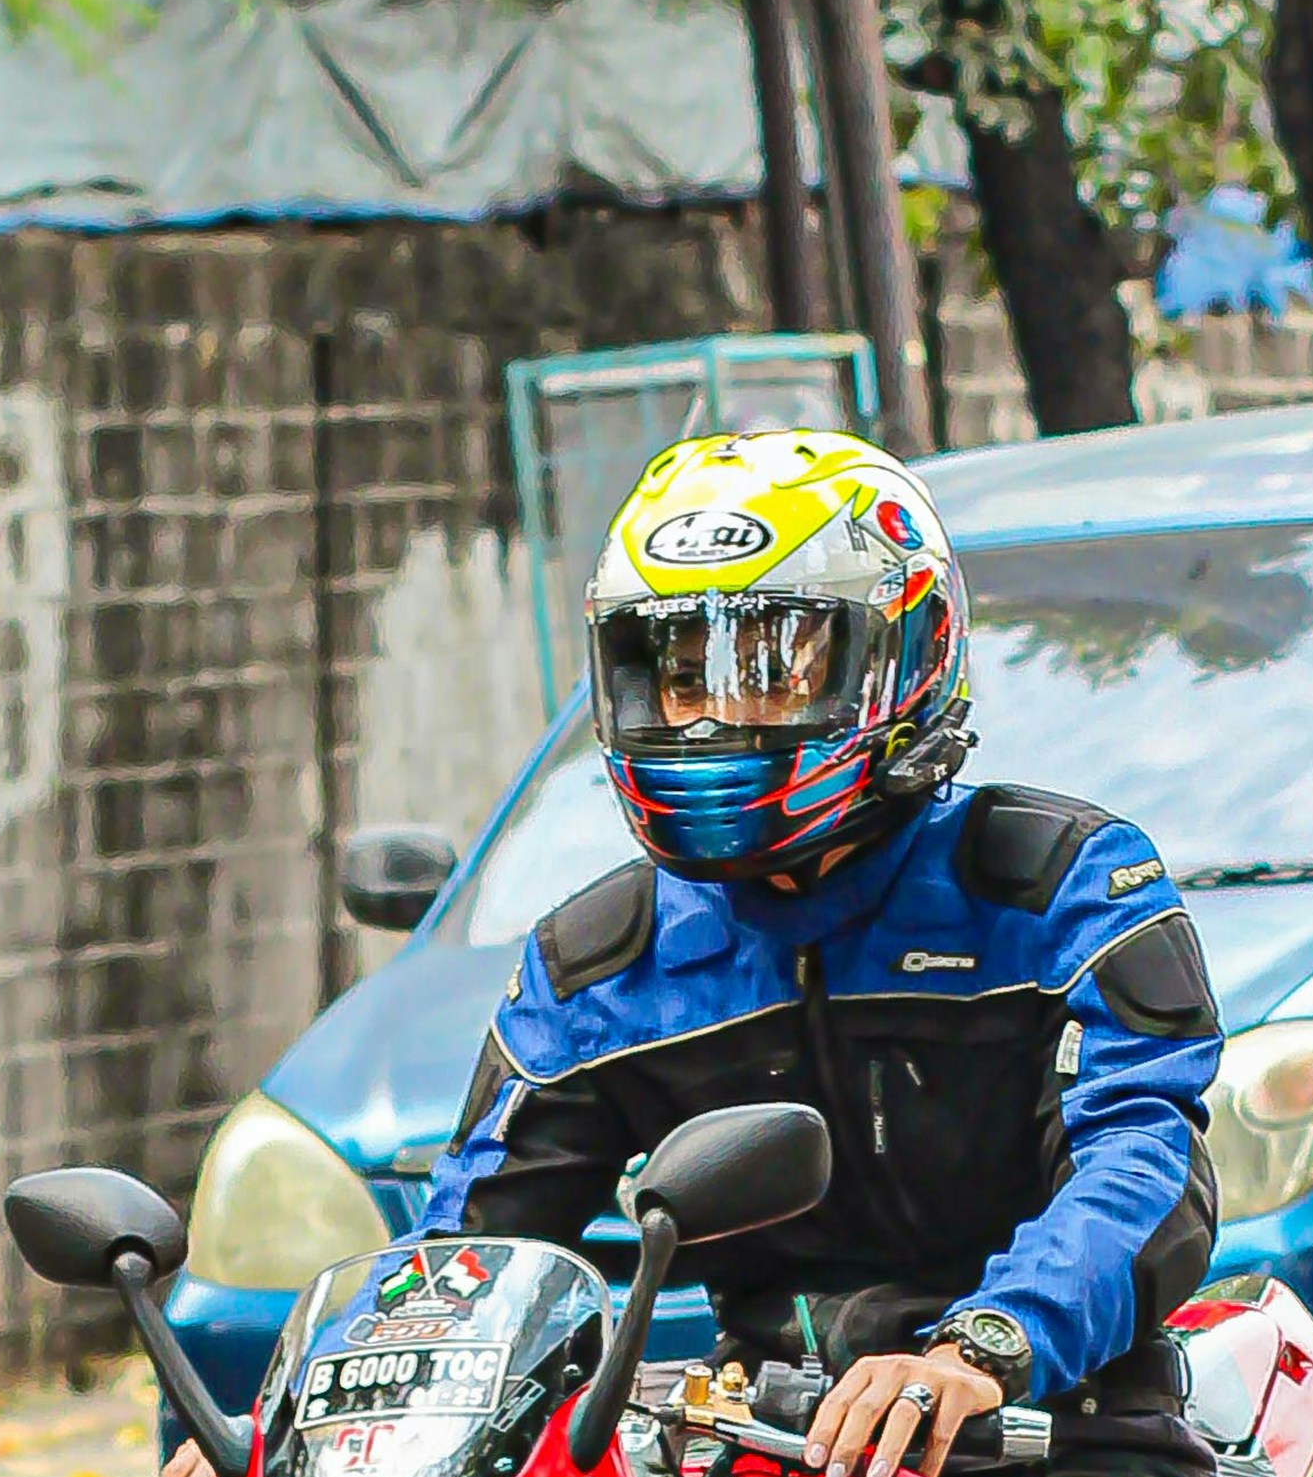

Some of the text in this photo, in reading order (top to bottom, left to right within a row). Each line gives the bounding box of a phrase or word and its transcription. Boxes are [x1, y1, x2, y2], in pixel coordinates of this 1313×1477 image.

[652, 516, 755, 549] ai
[309, 1350, 499, 1396] B 6000 TOC
